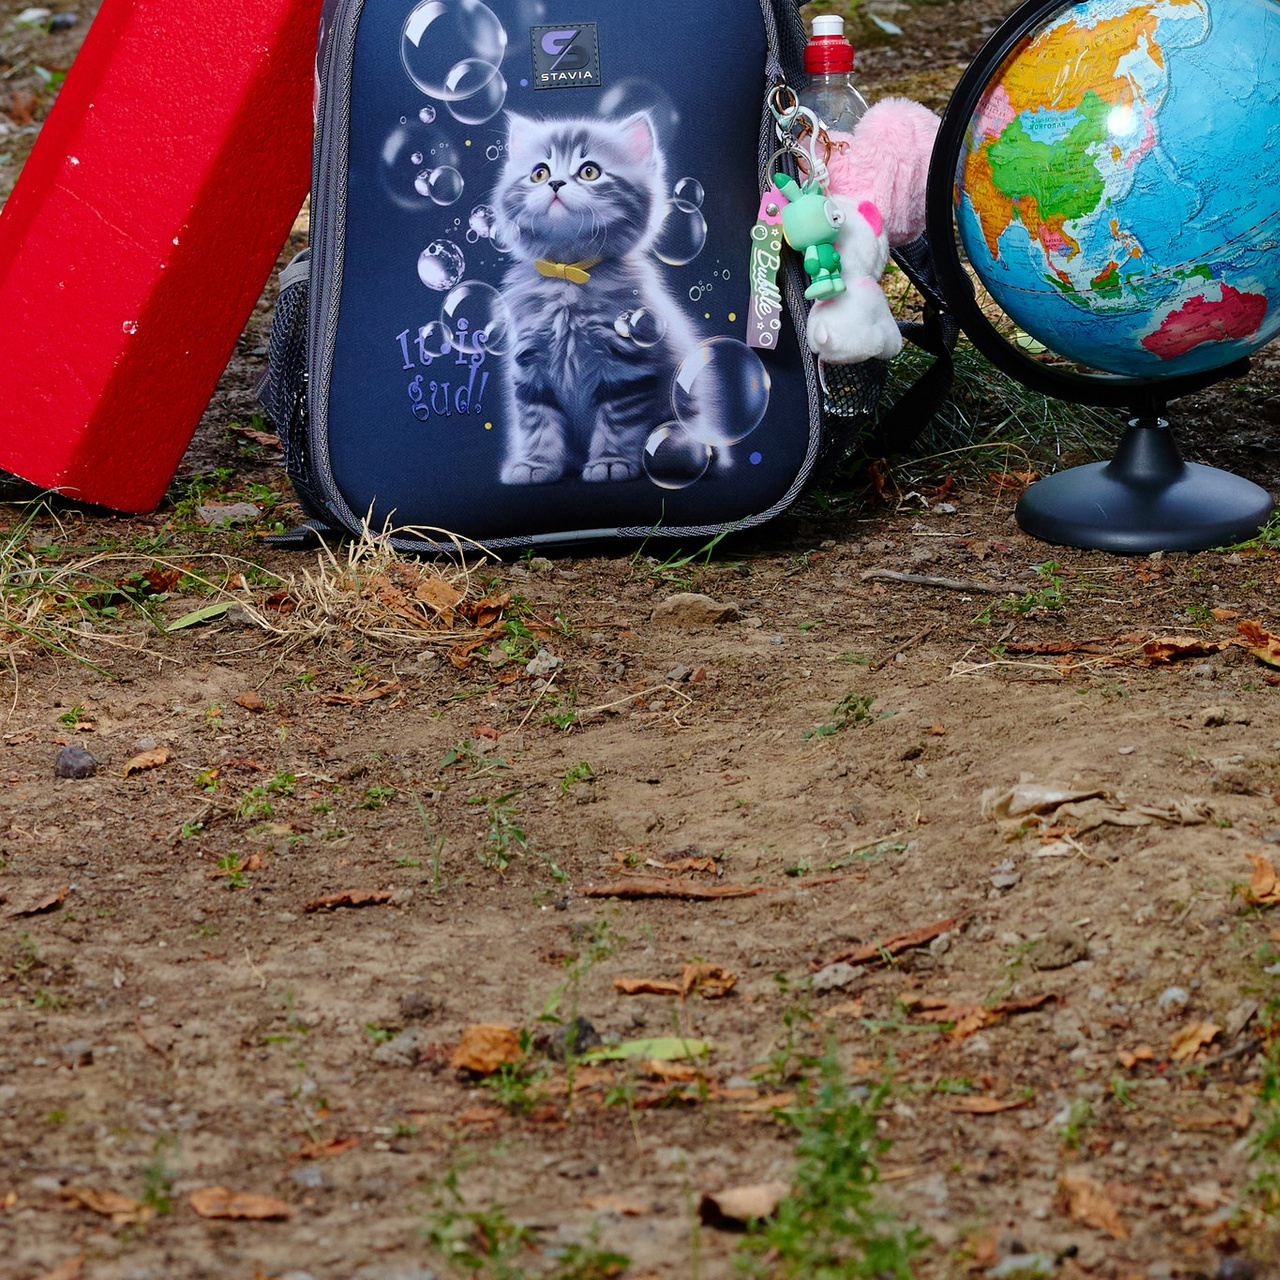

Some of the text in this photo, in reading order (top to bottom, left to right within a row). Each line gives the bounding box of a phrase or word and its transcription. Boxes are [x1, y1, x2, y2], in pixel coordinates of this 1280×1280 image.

[541, 71, 593, 82] STAVIA
[757, 248, 783, 316] Bubble
[395, 317, 489, 370] It is
[408, 364, 489, 421] gud!
